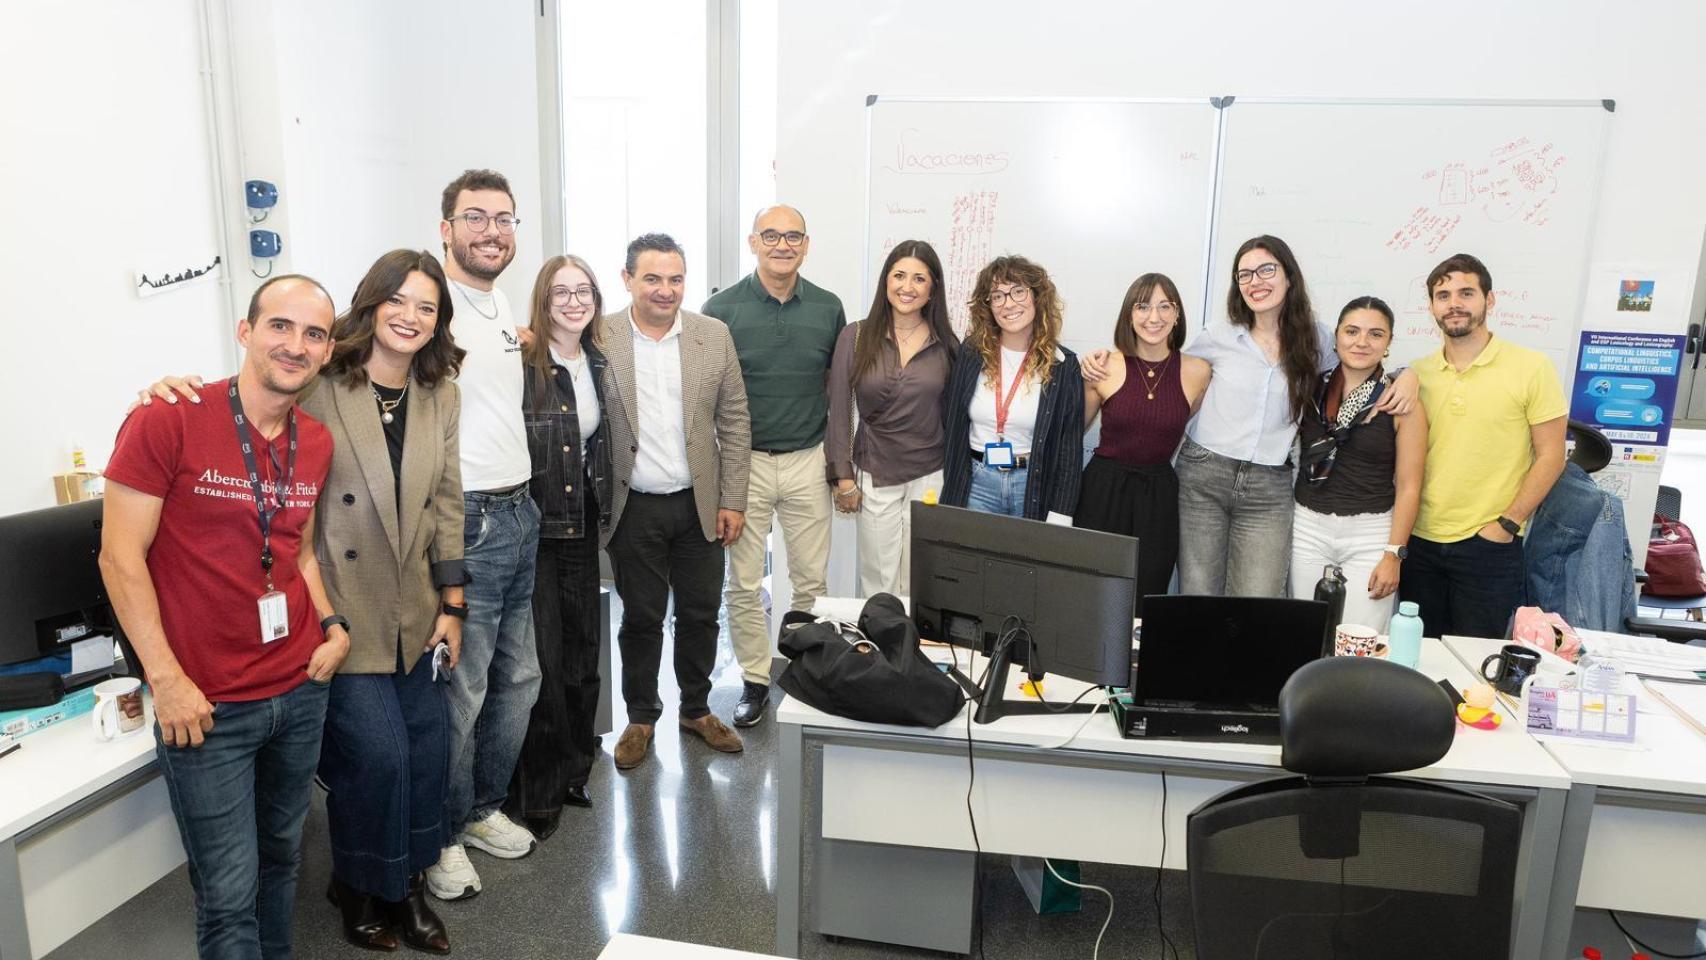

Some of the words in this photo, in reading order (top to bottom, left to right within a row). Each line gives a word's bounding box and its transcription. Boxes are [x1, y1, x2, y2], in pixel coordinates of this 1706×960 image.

[1587, 347, 1635, 356] COMPUTATIONAL
[1599, 355, 1623, 363] CORPUS
[1624, 356, 1659, 365] LINGUISTICS
[1598, 363, 1630, 372] ARTIFICIAL
[1632, 365, 1673, 374] INTELLIGENCE
[194, 486, 253, 501] ESTABLISHED
[1221, 724, 1249, 734] logitech
